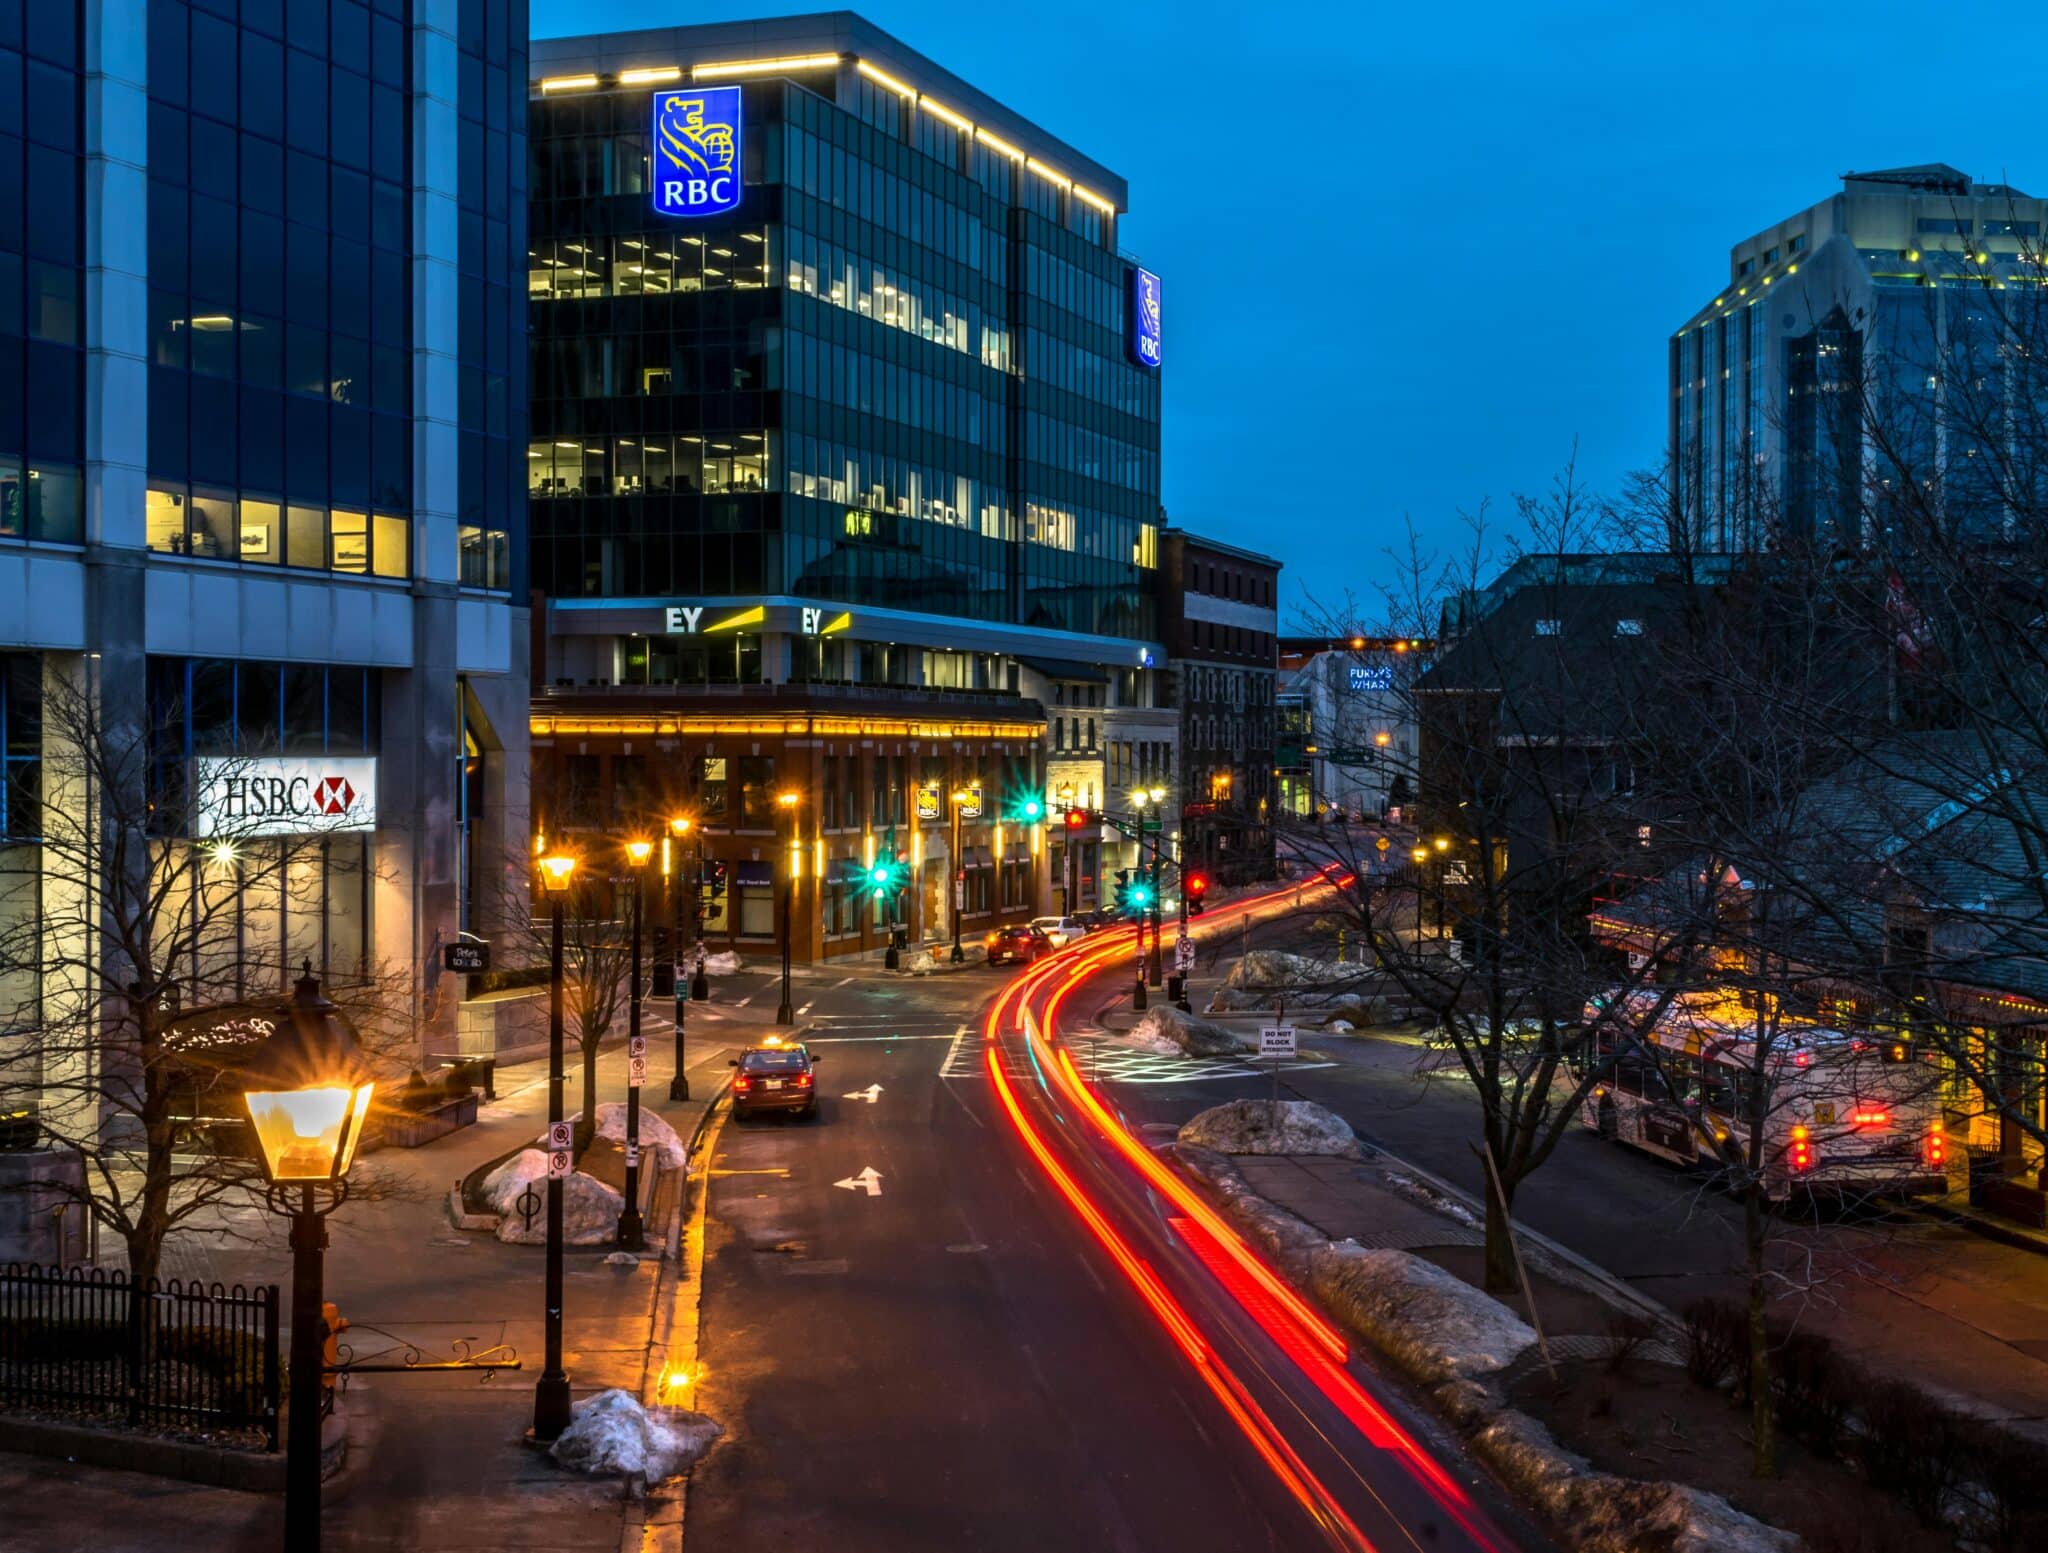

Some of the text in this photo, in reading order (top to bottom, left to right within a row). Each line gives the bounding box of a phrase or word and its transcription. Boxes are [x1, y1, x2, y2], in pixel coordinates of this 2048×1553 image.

[663, 177, 731, 207] RBC
[1141, 335, 1159, 361] RBC
[666, 607, 703, 633] EY
[802, 608, 822, 634] EY
[224, 777, 310, 818] HSBC
[919, 808, 937, 816] RBC
[962, 806, 979, 816] RBC
